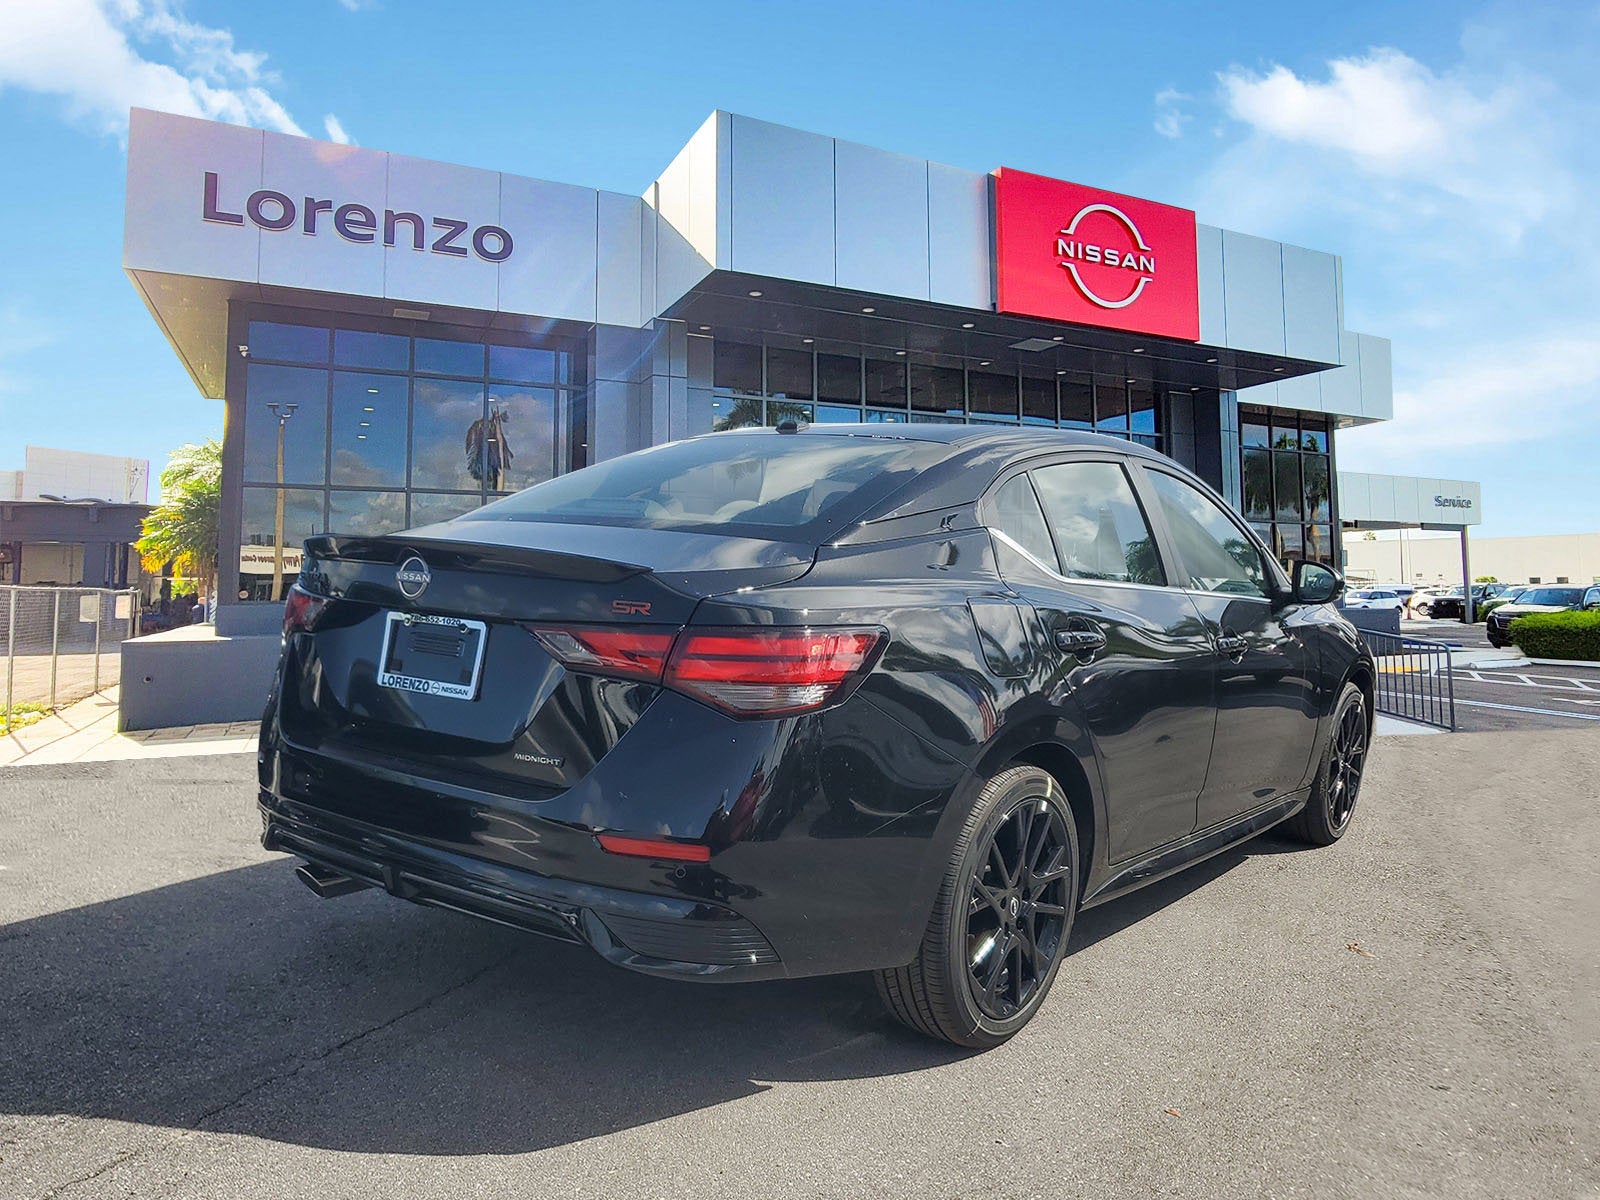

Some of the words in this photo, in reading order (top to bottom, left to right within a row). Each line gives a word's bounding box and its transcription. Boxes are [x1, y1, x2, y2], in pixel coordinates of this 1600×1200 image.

[202, 171, 514, 262] Lorenzo
[1057, 238, 1155, 273] NISSAN
[1434, 495, 1472, 509] Service
[611, 599, 651, 616] SR
[381, 674, 430, 692] LORENZO
[440, 685, 469, 697] NISSAN
[513, 753, 561, 766] MIDNIGHT
